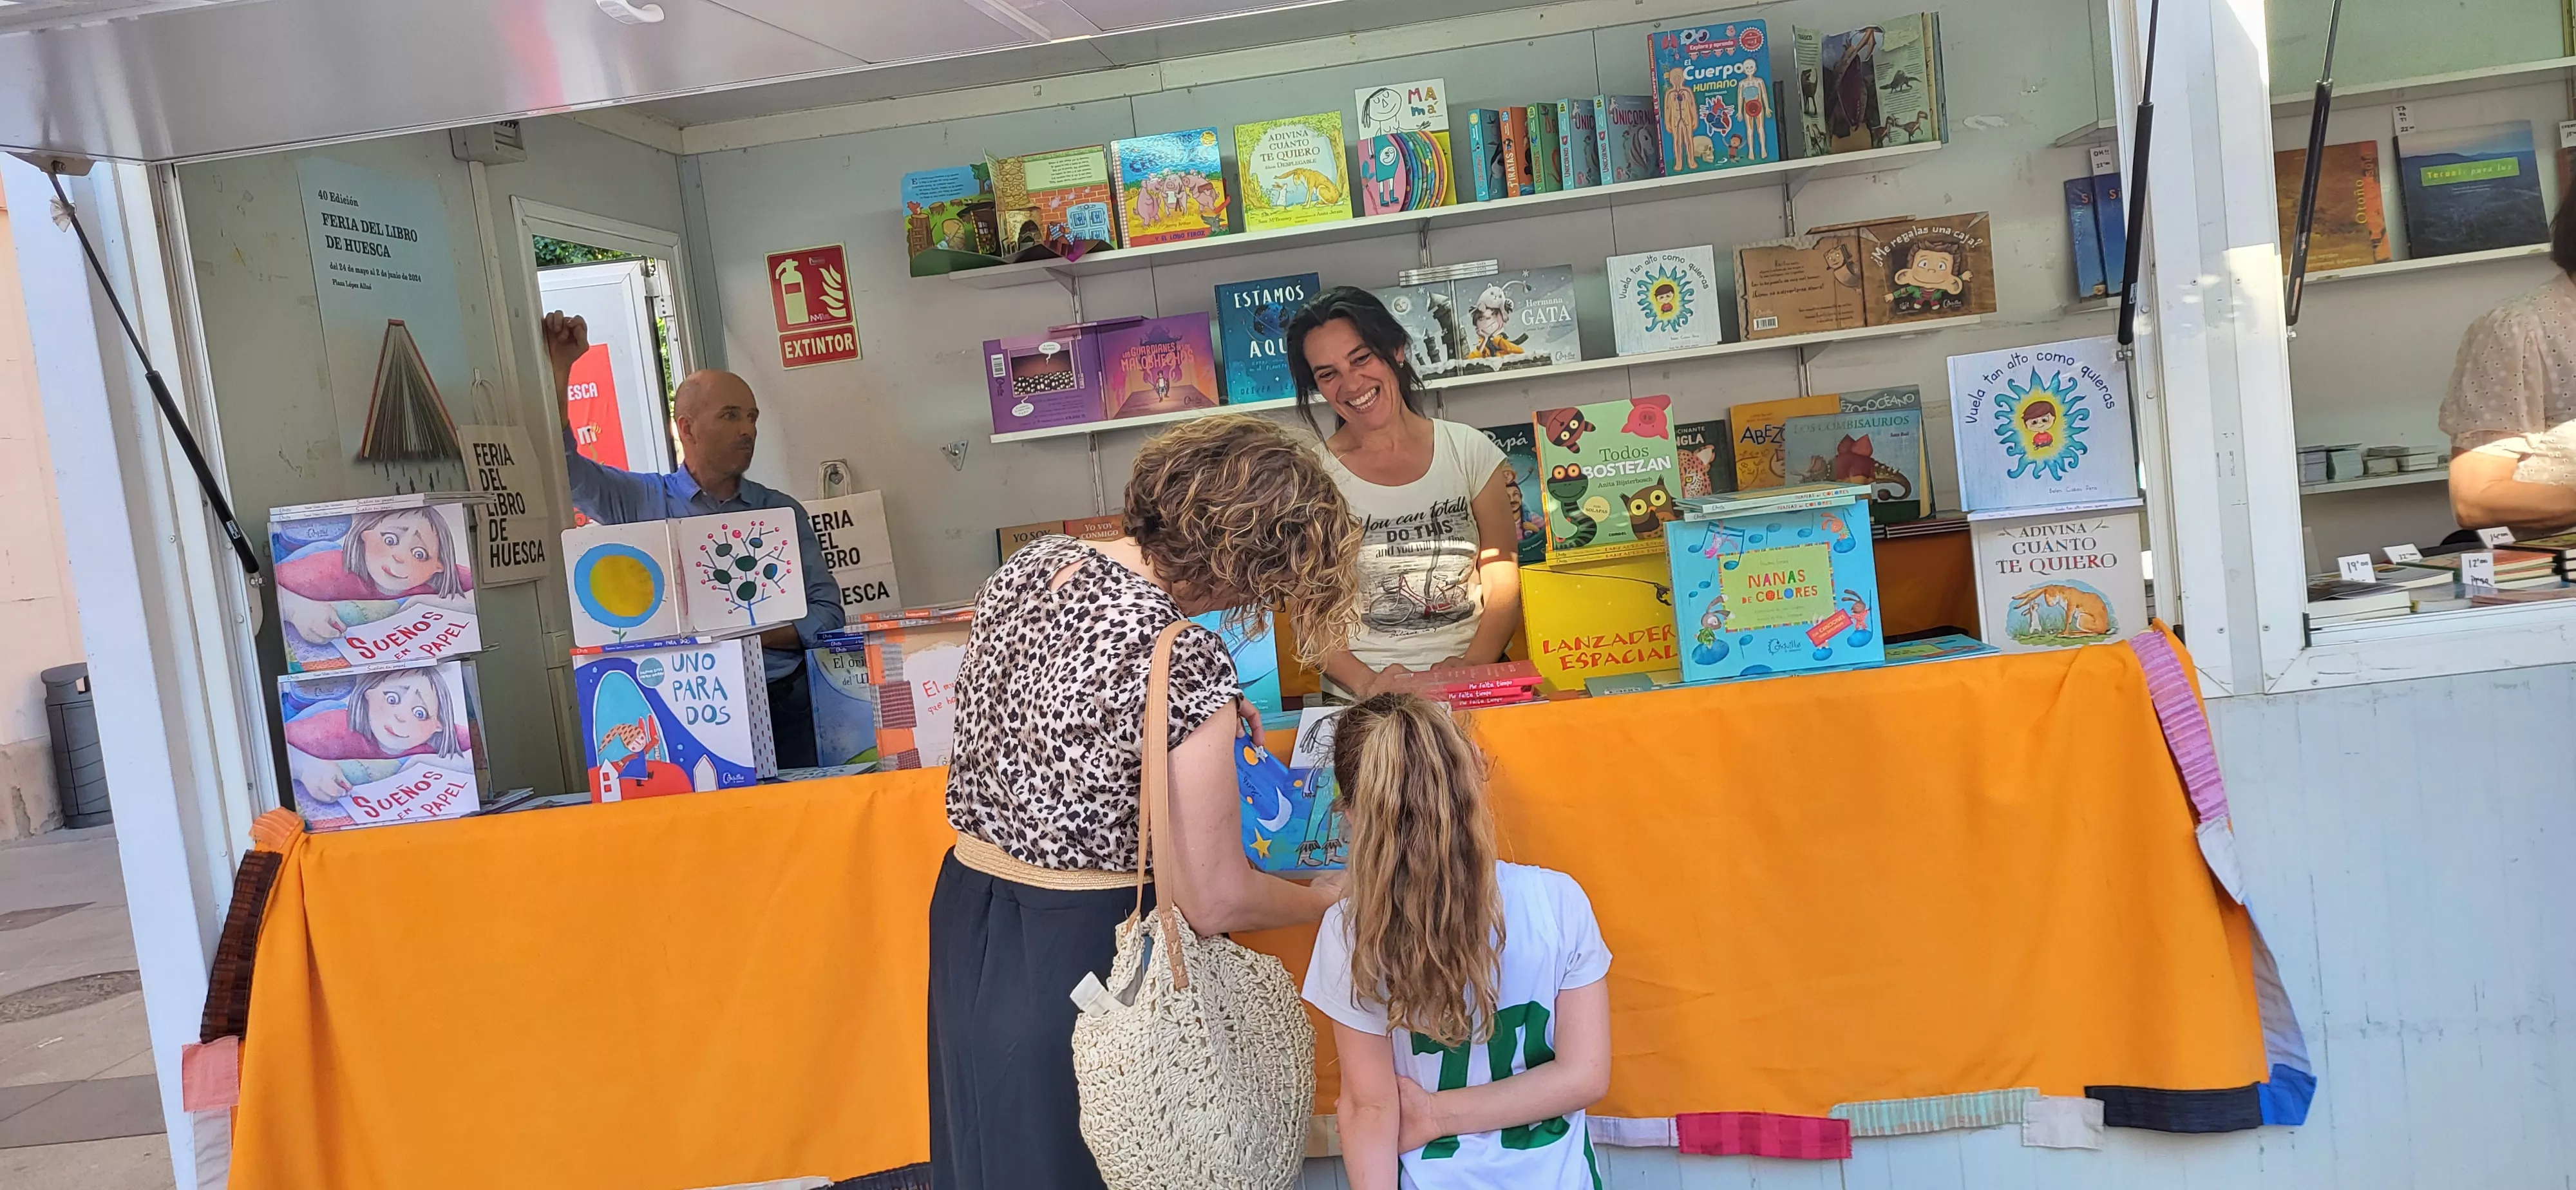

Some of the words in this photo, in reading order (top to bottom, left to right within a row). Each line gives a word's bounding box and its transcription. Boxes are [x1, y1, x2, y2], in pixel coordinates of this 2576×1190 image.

[1683, 62, 1744, 80] Cuerpo
[1693, 79, 1738, 92] HUMANO
[1268, 129, 1309, 142] ADIVINA
[1269, 138, 1309, 150] CUÁNTO
[1260, 153, 1274, 162] TE
[1276, 146, 1320, 161] QUIERO
[1276, 158, 1317, 168] DESPLEGABLE
[1506, 152, 1519, 188] PIRATAS
[317, 189, 328, 201] 40
[329, 192, 359, 207] Edición
[2354, 179, 2367, 223] Otoño
[321, 212, 359, 232] FERIA
[360, 220, 384, 236] DEL
[385, 224, 418, 242] LIBRO
[325, 235, 342, 250] DE
[343, 238, 392, 258] HUESCA
[1871, 245, 1891, 267] ¿Me
[1890, 225, 1929, 247] regalas
[1953, 231, 1984, 248] caja?
[346, 280, 359, 288] López
[355, 267, 369, 276] mayo
[388, 270, 401, 279] junio
[408, 273, 422, 282] 2024
[1618, 277, 1632, 299] Vuela
[1629, 265, 1643, 275] tan
[1645, 254, 1658, 265] alto
[1662, 254, 1685, 264] como
[1689, 263, 1709, 289] quieras
[1234, 285, 1304, 309] ESTAMOS
[1526, 298, 1563, 307] Hermana
[1521, 305, 1572, 325] GATA
[784, 333, 854, 359] EXTINTOR
[1130, 342, 1176, 355] GUARDIANES
[1965, 388, 1986, 424] Vuela
[1982, 368, 2004, 384] tan
[2007, 352, 2029, 370] alto
[2037, 352, 2074, 366] como
[2081, 365, 2115, 410] quieras
[1794, 424, 1815, 433] LOS
[1818, 415, 1909, 431] COMBISAURIOS
[1483, 430, 1528, 452] Papá
[473, 442, 515, 466] FERIA
[1599, 446, 1649, 462] Todos
[1582, 455, 1672, 479] BOSTEZAN
[479, 468, 507, 491] DEL
[1616, 477, 1653, 486] Bijsterbosch
[808, 509, 854, 533] ERIA
[1396, 511, 1426, 525] can
[1430, 496, 1468, 522] totally
[489, 517, 508, 542] DE
[1013, 533, 1028, 543] YO
[1081, 529, 1119, 540] CONMIGO
[1387, 529, 1409, 542] DO
[1414, 520, 1453, 538] THIS
[2019, 523, 2087, 538] ADIVINA
[489, 540, 545, 568] HUESCA
[1376, 548, 1394, 558] and
[1397, 545, 1413, 556] you
[1416, 540, 1431, 551] will
[2012, 537, 2096, 554] CUÁNTO
[1995, 559, 2022, 574] TE
[2030, 553, 2117, 575] QUIERO
[1748, 569, 1806, 588] NANAS
[1756, 585, 1817, 602] COLORES
[346, 612, 443, 659] SUEÑOS
[394, 648, 411, 660] EN
[419, 621, 470, 657] PAPEL
[1542, 623, 1676, 654] LANZADER
[672, 652, 715, 673] UNO
[833, 656, 845, 669] El
[1559, 645, 1678, 671] ESPACIAL
[672, 676, 728, 703] PARA
[842, 677, 852, 686] del
[922, 679, 940, 697] El
[685, 704, 731, 726] DOS
[928, 703, 942, 713] que
[352, 771, 443, 818] SUEÑOS
[397, 808, 413, 820] EN
[420, 782, 468, 818] PAPEL
